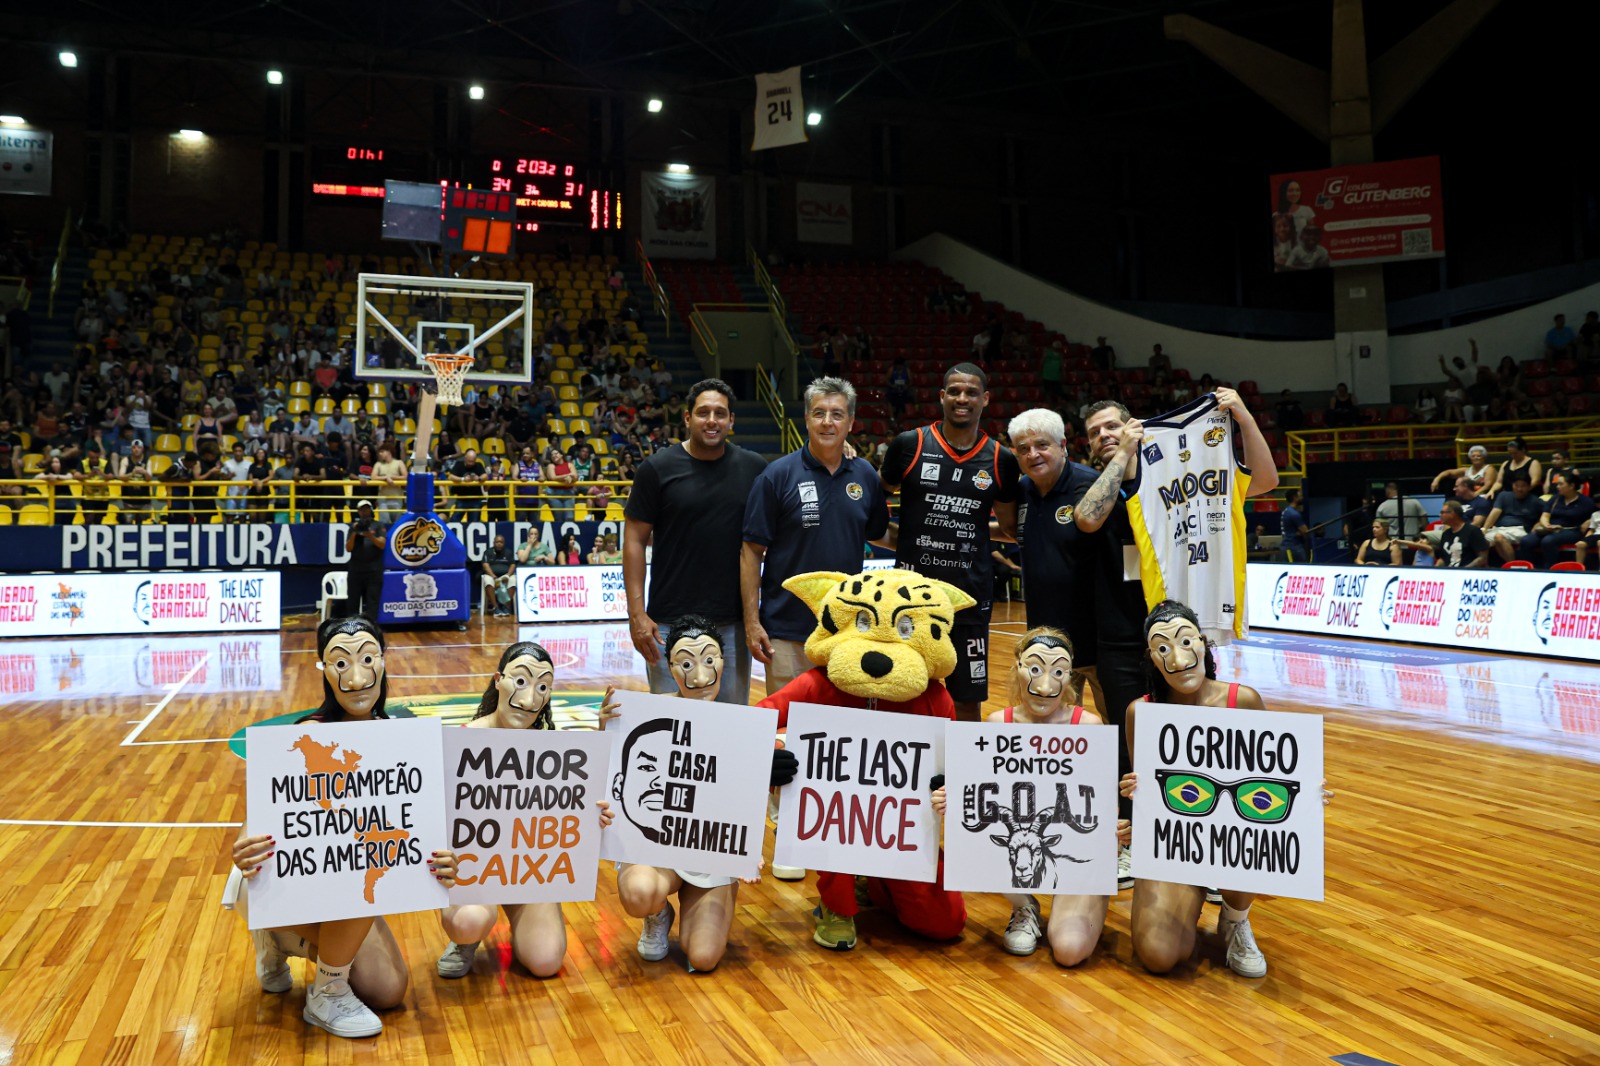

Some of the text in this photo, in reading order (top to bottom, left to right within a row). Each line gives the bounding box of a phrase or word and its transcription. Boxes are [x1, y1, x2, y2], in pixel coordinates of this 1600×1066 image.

[768, 100, 792, 124] 24
[492, 177, 511, 192] 34
[564, 182, 584, 196] 31
[1343, 185, 1431, 204] GUTENBERG
[799, 200, 850, 218] CNA
[925, 493, 982, 510] CAXIAS
[1158, 469, 1228, 511] MOGI
[932, 503, 972, 516] DO SUL
[924, 516, 976, 531] ELETRÔNICO
[62, 524, 298, 569] PREFEITURA
[401, 546, 427, 557] MOGI
[932, 555, 974, 570] banrisul
[219, 578, 264, 599] THE LAST
[1332, 573, 1369, 599] THE LAST
[1462, 578, 1499, 593] MAIOR
[384, 600, 457, 612] MOGI DAS CRUZES
[602, 593, 614, 602] DO
[603, 603, 628, 614] CAIX
[1459, 592, 1497, 607] PONTUADOR
[219, 601, 262, 624] DANCE
[1326, 600, 1363, 628] DANCE
[1456, 608, 1494, 624] DO NBB
[1455, 623, 1491, 639] CAIXA
[966, 637, 986, 657] 24
[671, 719, 692, 747] LA
[996, 734, 1023, 753] DE
[1029, 735, 1089, 755] 9.000
[1158, 723, 1299, 775] O GRINGO
[456, 746, 588, 780] MAIOR
[668, 750, 717, 783] CASA
[799, 731, 931, 792] THE LAST
[993, 755, 1074, 776] PONTOS
[272, 762, 423, 803] MULTICAMPEÃO
[455, 782, 586, 811] PONTUADOR
[670, 786, 689, 809] DE
[962, 783, 977, 823] THE
[284, 802, 414, 839] ESTADUAL E
[797, 786, 922, 852] DANCE
[452, 815, 581, 850] DO NBB
[659, 814, 748, 857] SHAMELL
[276, 834, 423, 878] DAS AMÉRICAS
[1154, 817, 1301, 875] MAIS MOGIANO
[454, 852, 576, 887] CAIXA
